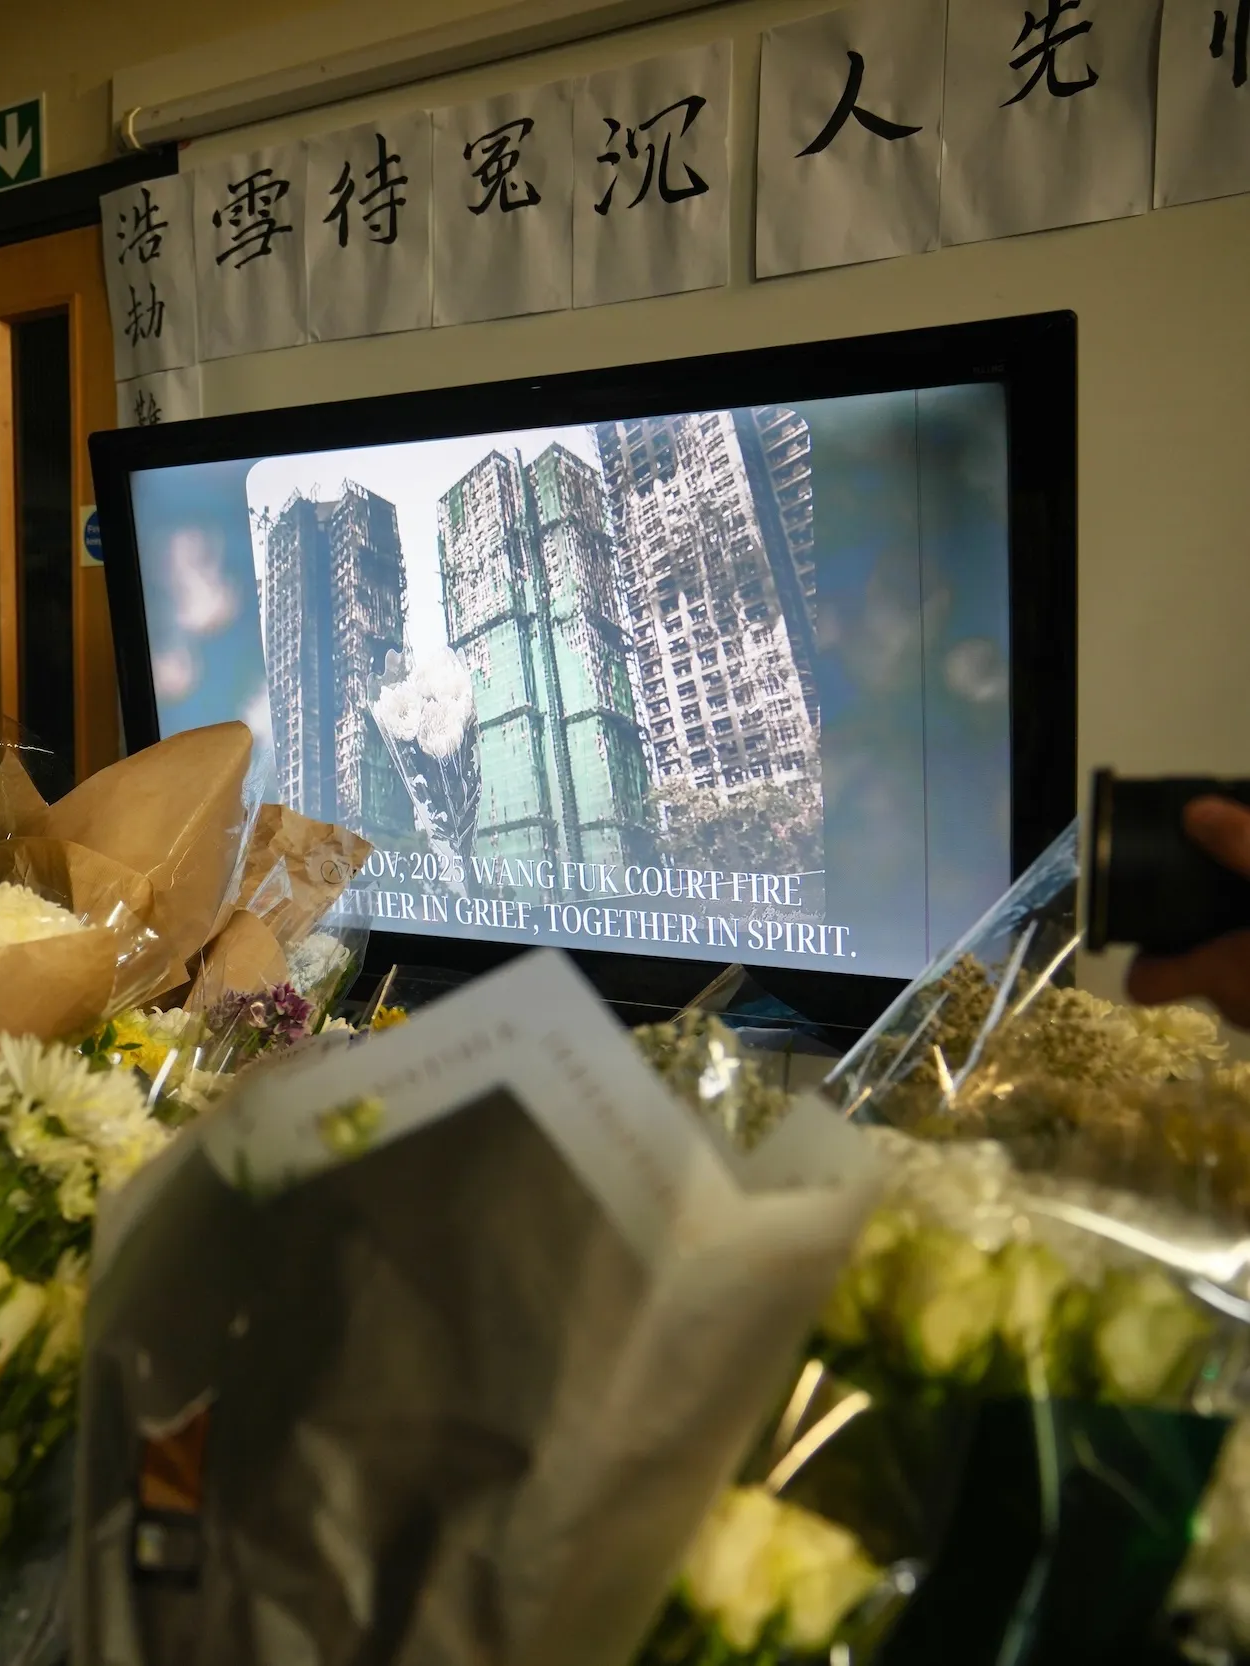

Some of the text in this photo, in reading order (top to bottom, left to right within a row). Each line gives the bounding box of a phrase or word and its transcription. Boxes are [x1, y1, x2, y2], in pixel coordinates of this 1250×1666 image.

[360, 850, 802, 906] OV, 2025 WANG FUK COURT FIRE
[421, 894, 448, 923] IN
[455, 897, 540, 935] GRIEF,
[544, 904, 700, 945] TOGETHER
[706, 916, 739, 947] IN
[748, 919, 857, 958] SPIRIT.
